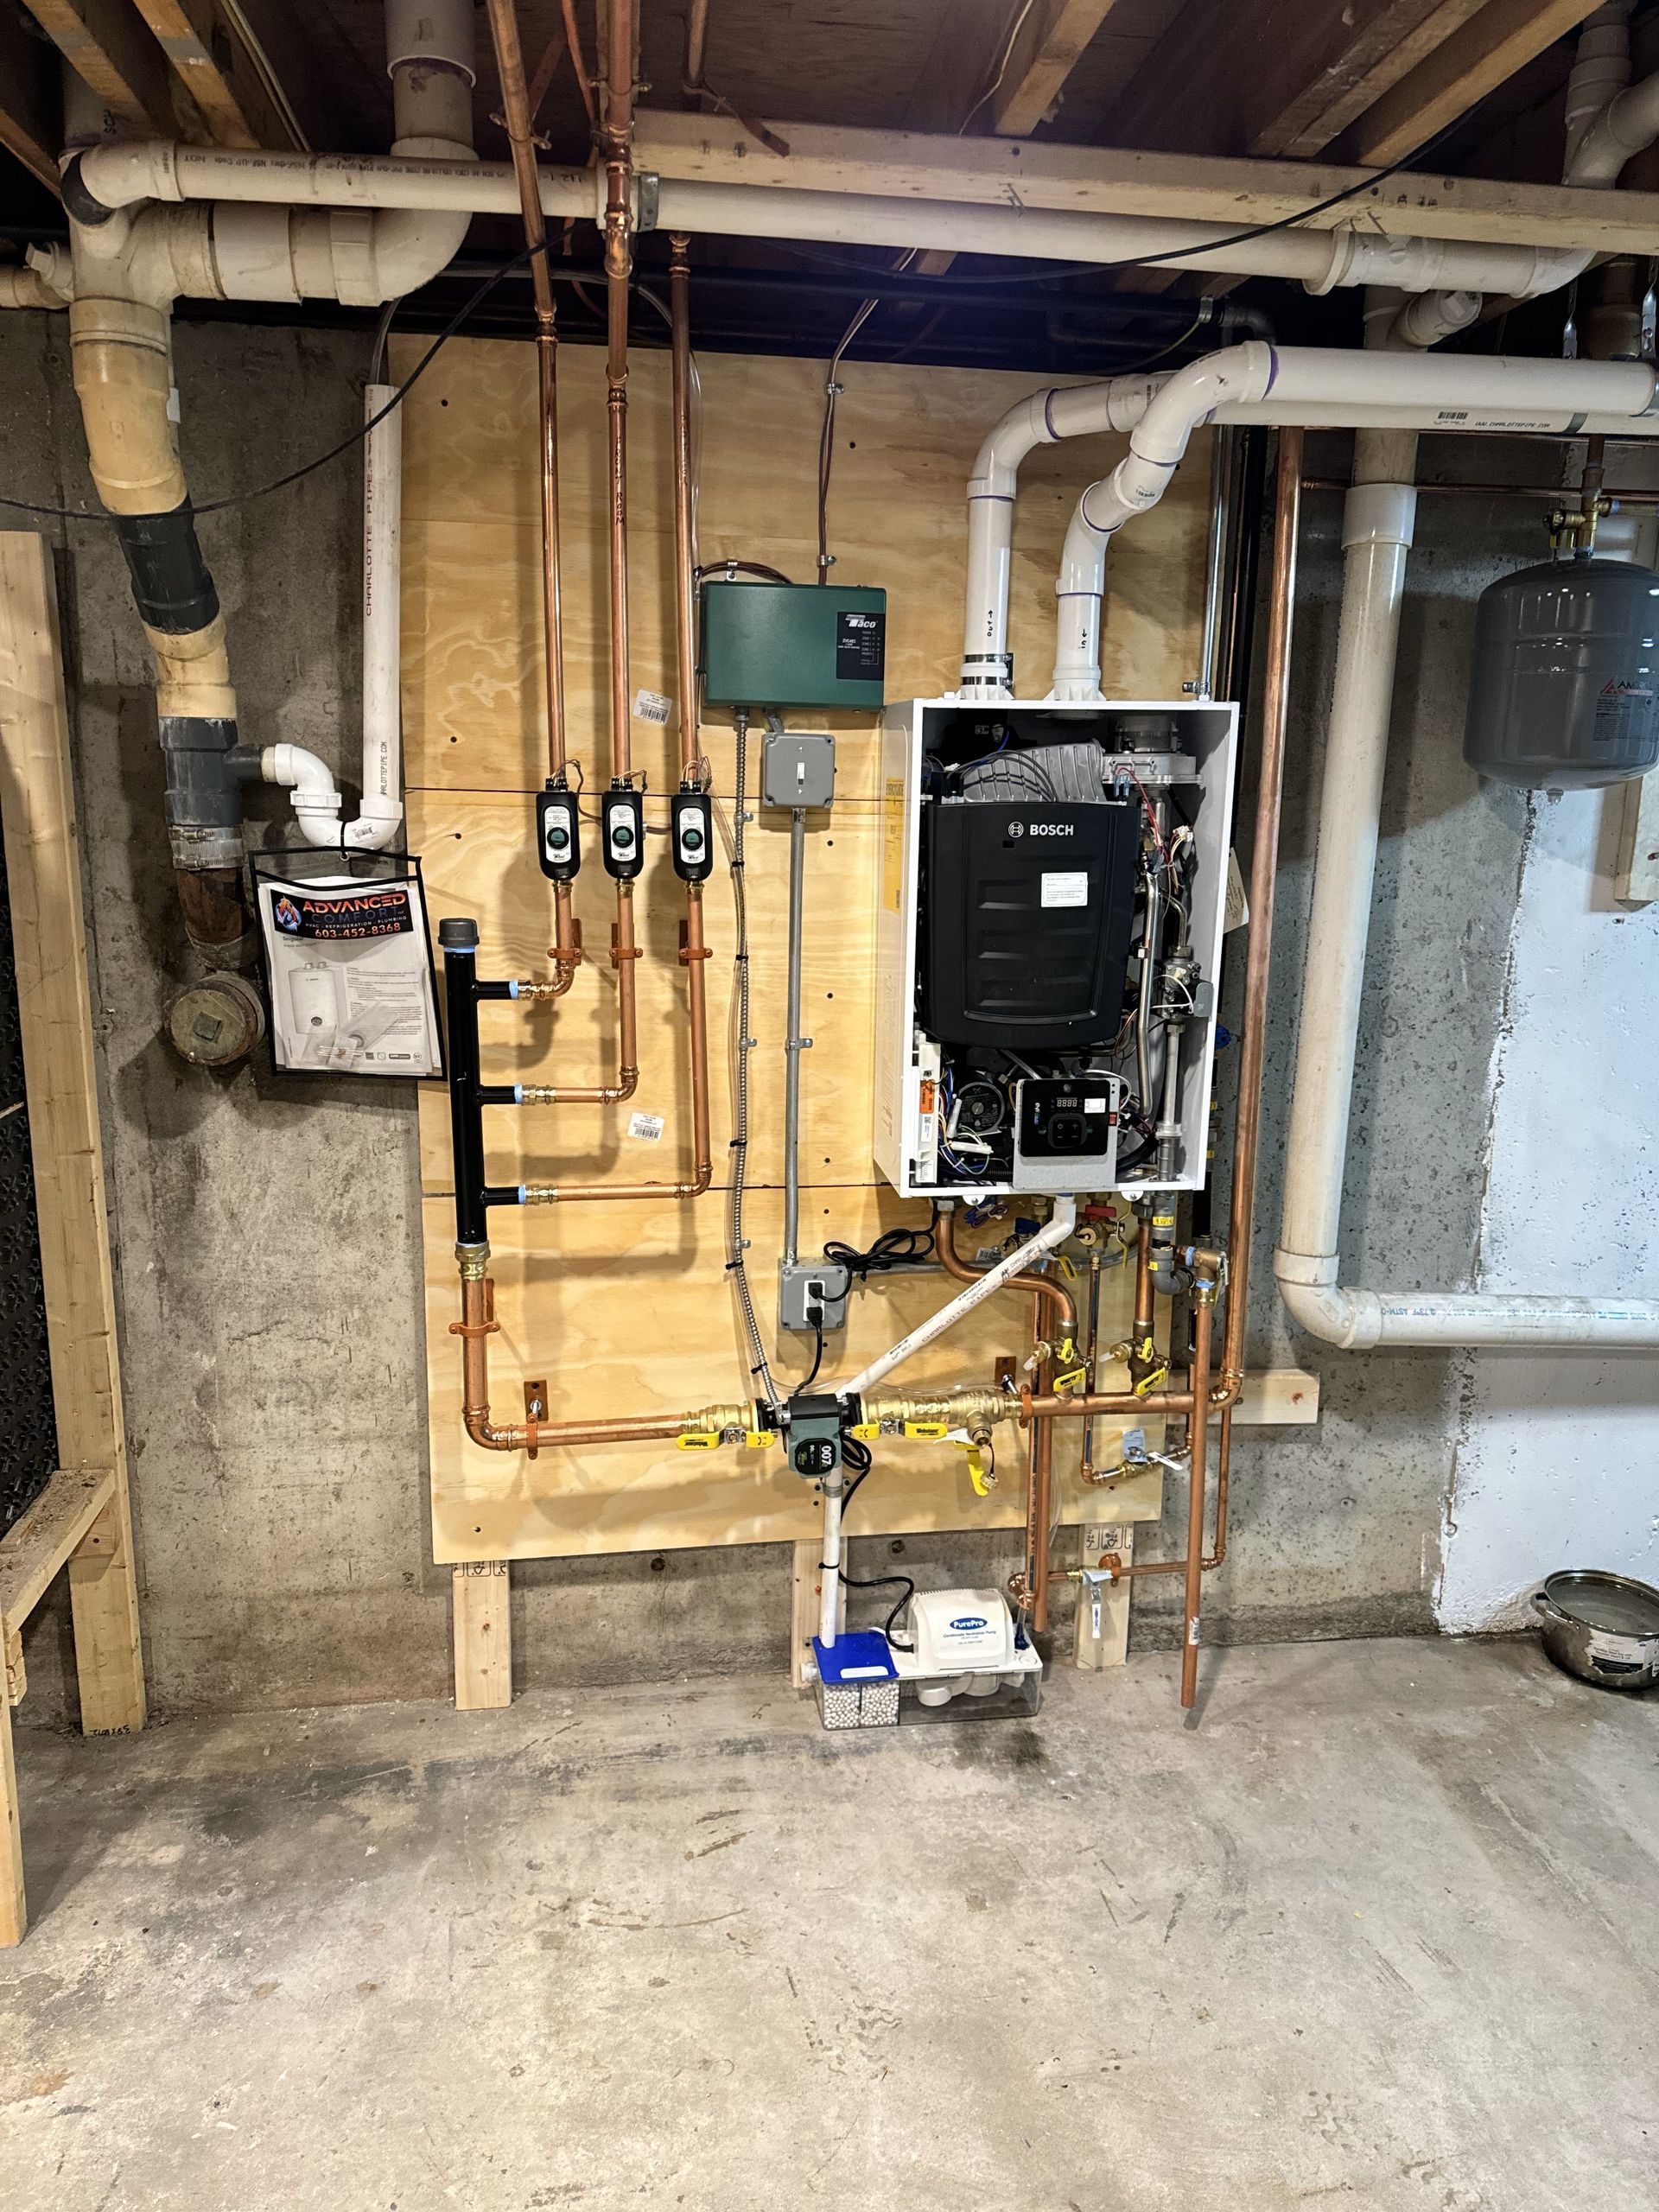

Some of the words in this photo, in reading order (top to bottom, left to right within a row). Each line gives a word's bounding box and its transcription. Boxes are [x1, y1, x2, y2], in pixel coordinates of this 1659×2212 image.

[615, 492, 625, 526] ROOM
[1029, 823, 1075, 836] BOSCH
[302, 893, 406, 914] ADVANCED
[311, 906, 398, 924] COMFORT
[378, 916, 407, 925] PLUMBING
[315, 922, 401, 939] 603-452-8368
[921, 1306, 968, 1343] CHARLOTTE
[953, 1619, 985, 1629] PurePro
